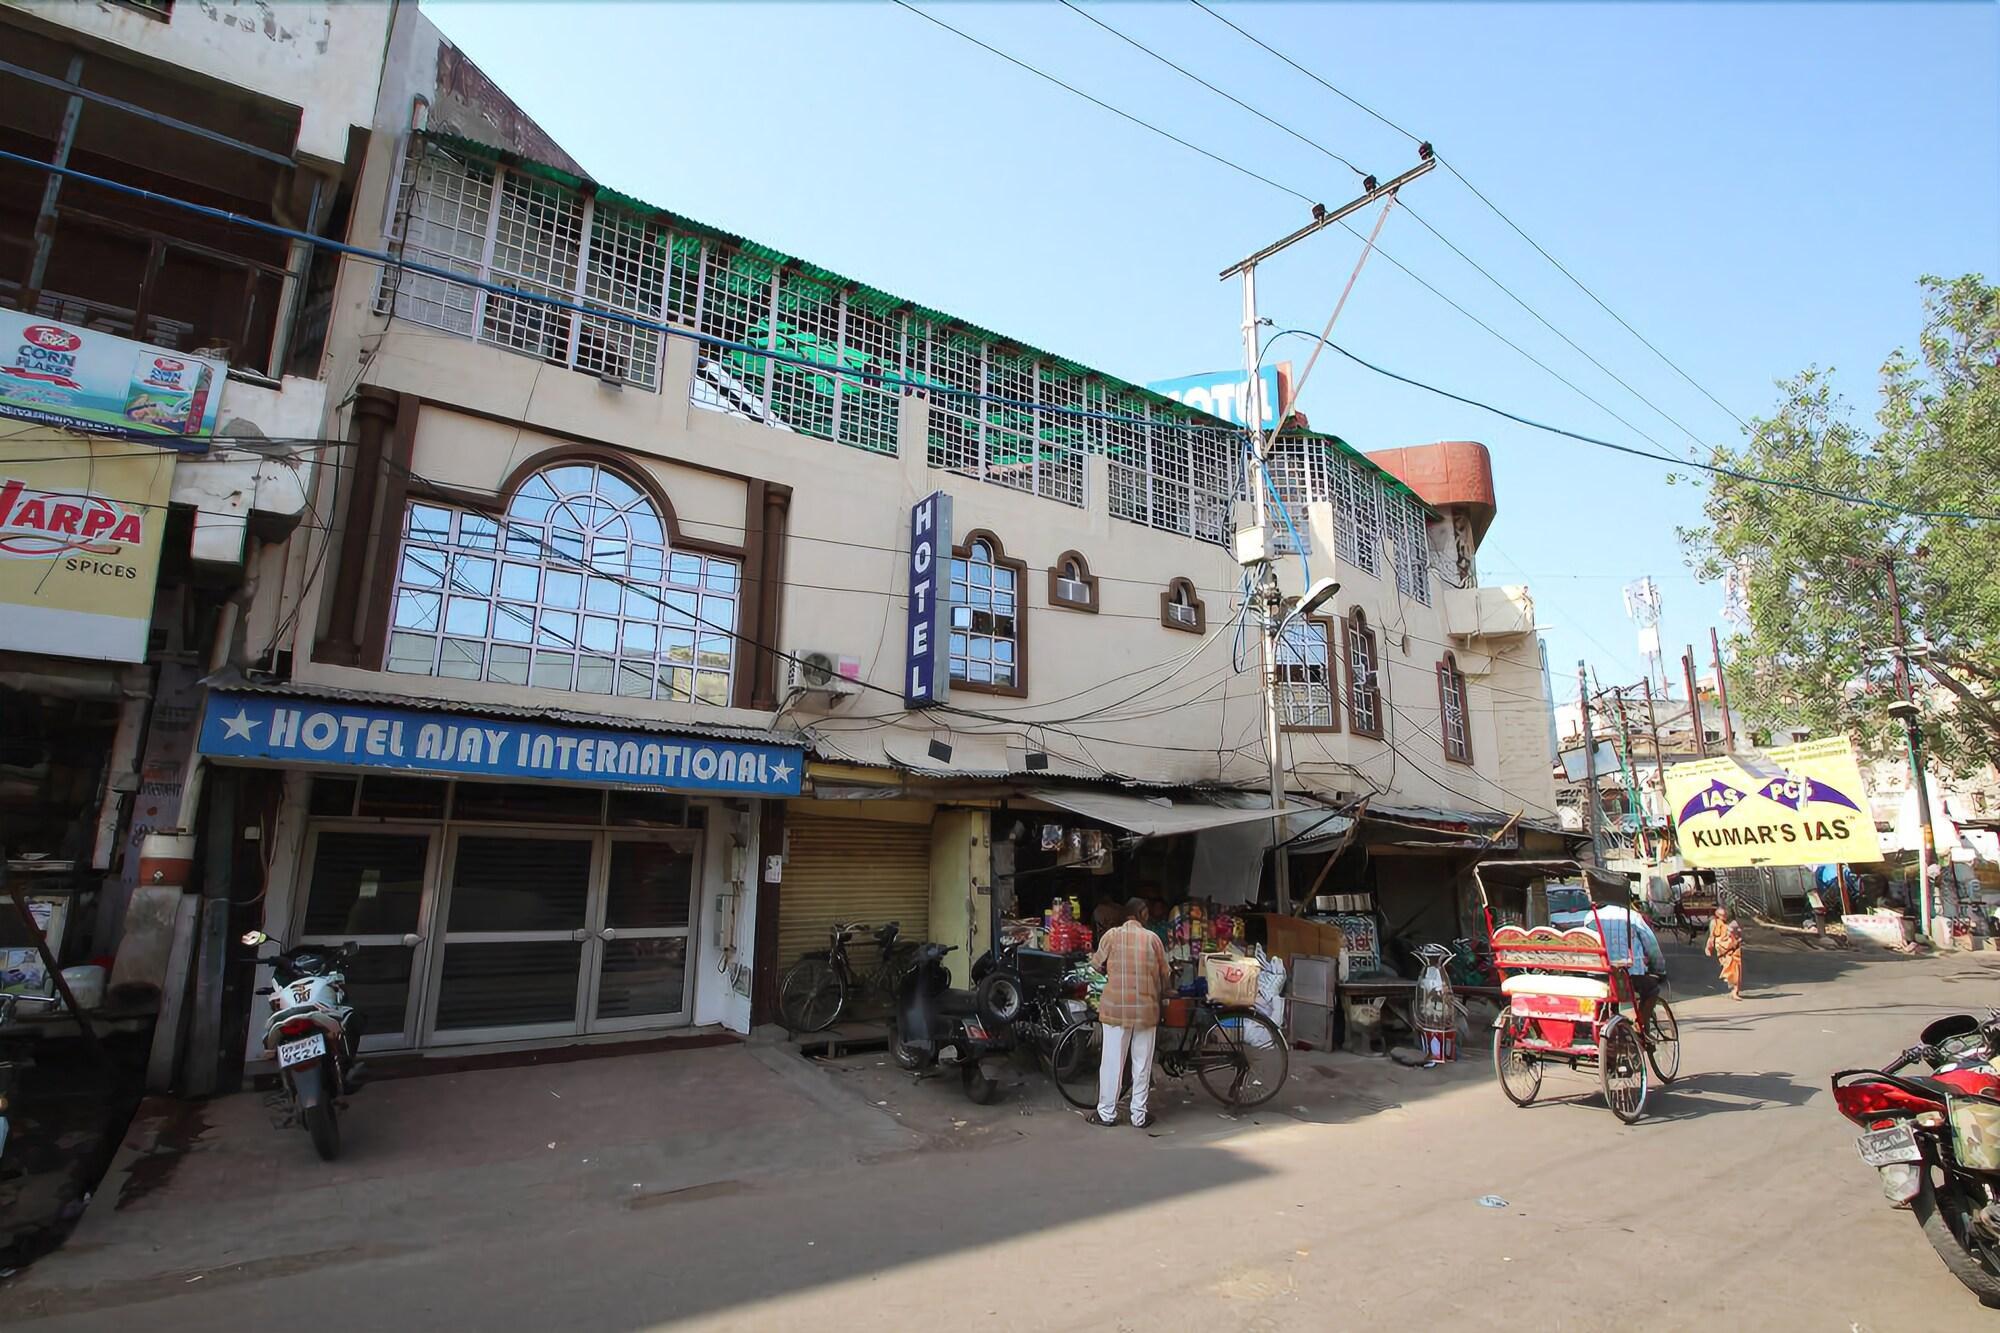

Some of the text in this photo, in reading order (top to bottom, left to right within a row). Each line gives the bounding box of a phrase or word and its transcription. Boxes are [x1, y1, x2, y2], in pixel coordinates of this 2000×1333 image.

[18, 345, 76, 367] CORN
[65, 558, 137, 580] SPICES
[912, 499, 932, 698] HOTEL
[268, 708, 768, 784] HOTEL AJAY INTERNATIONAL
[1701, 788, 1739, 809] IAS
[1692, 818, 1851, 848] KUMAR'S IAS
